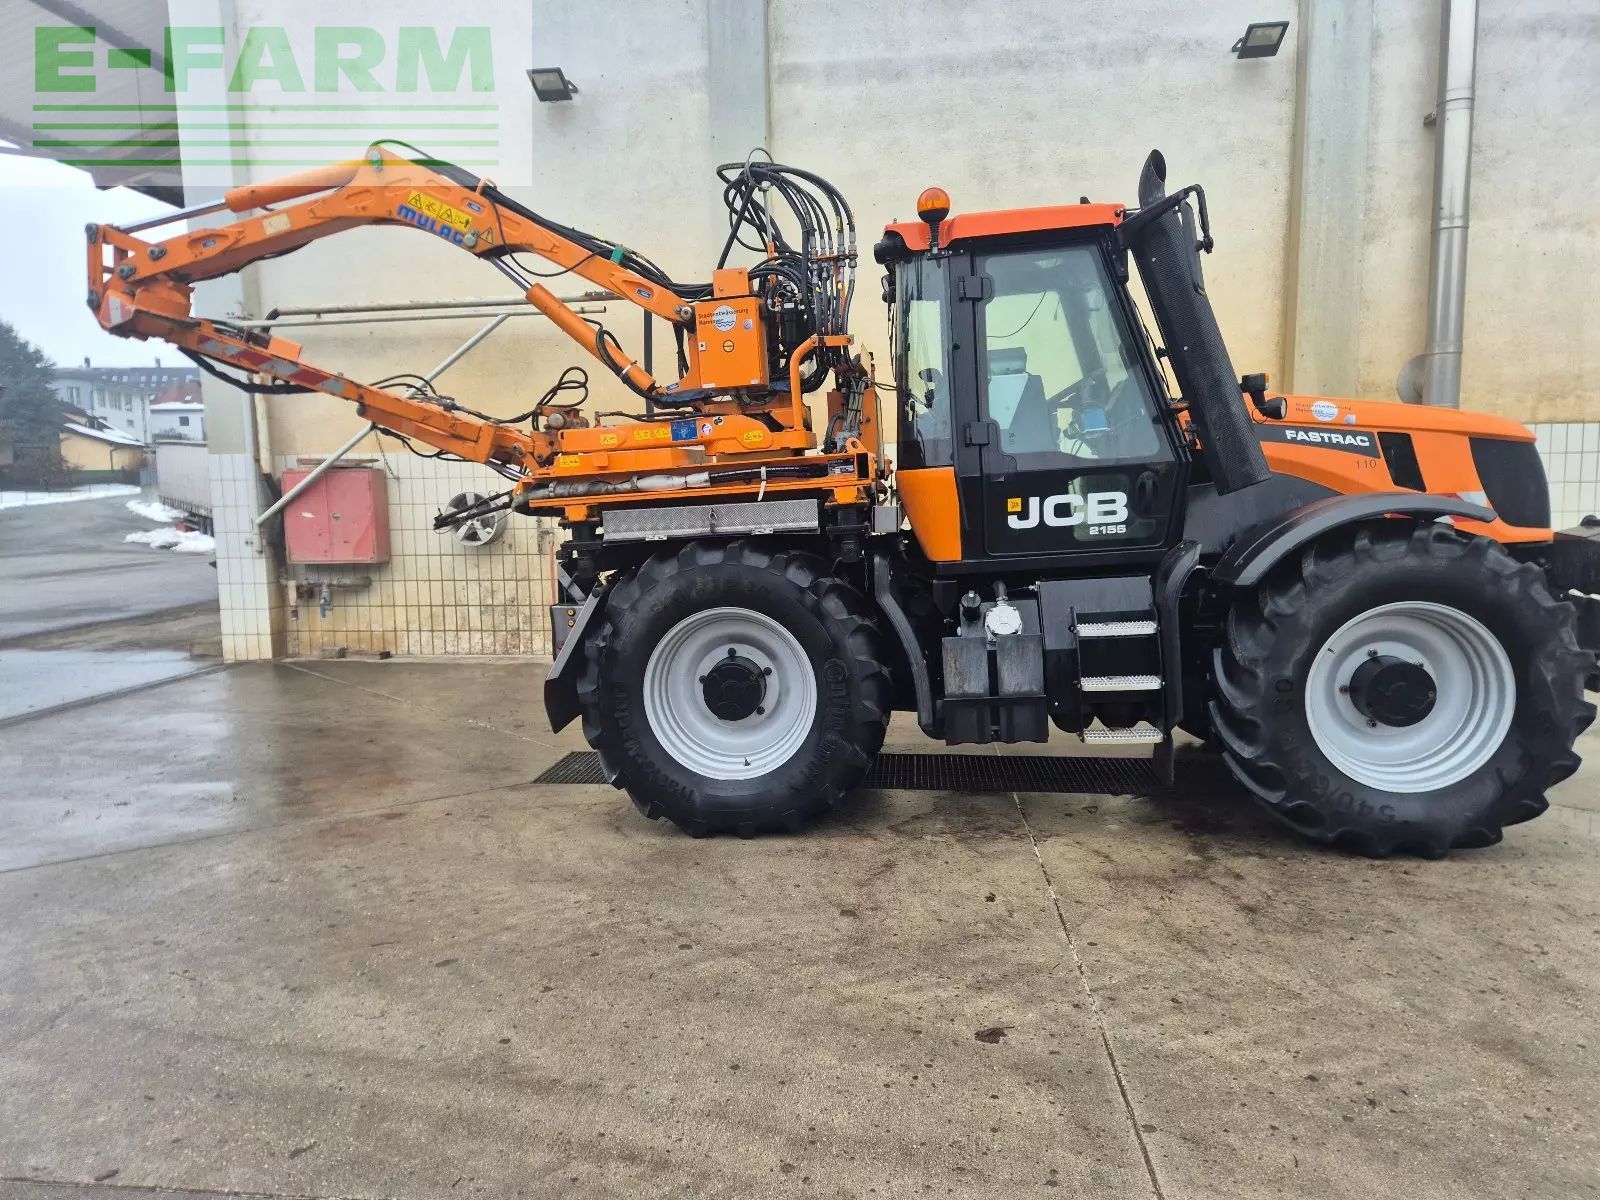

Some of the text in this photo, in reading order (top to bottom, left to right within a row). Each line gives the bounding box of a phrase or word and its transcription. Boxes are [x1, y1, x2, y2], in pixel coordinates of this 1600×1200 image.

[1284, 429, 1370, 447] FASTRAC
[1355, 459, 1377, 470] 110
[1007, 491, 1129, 530] JCB
